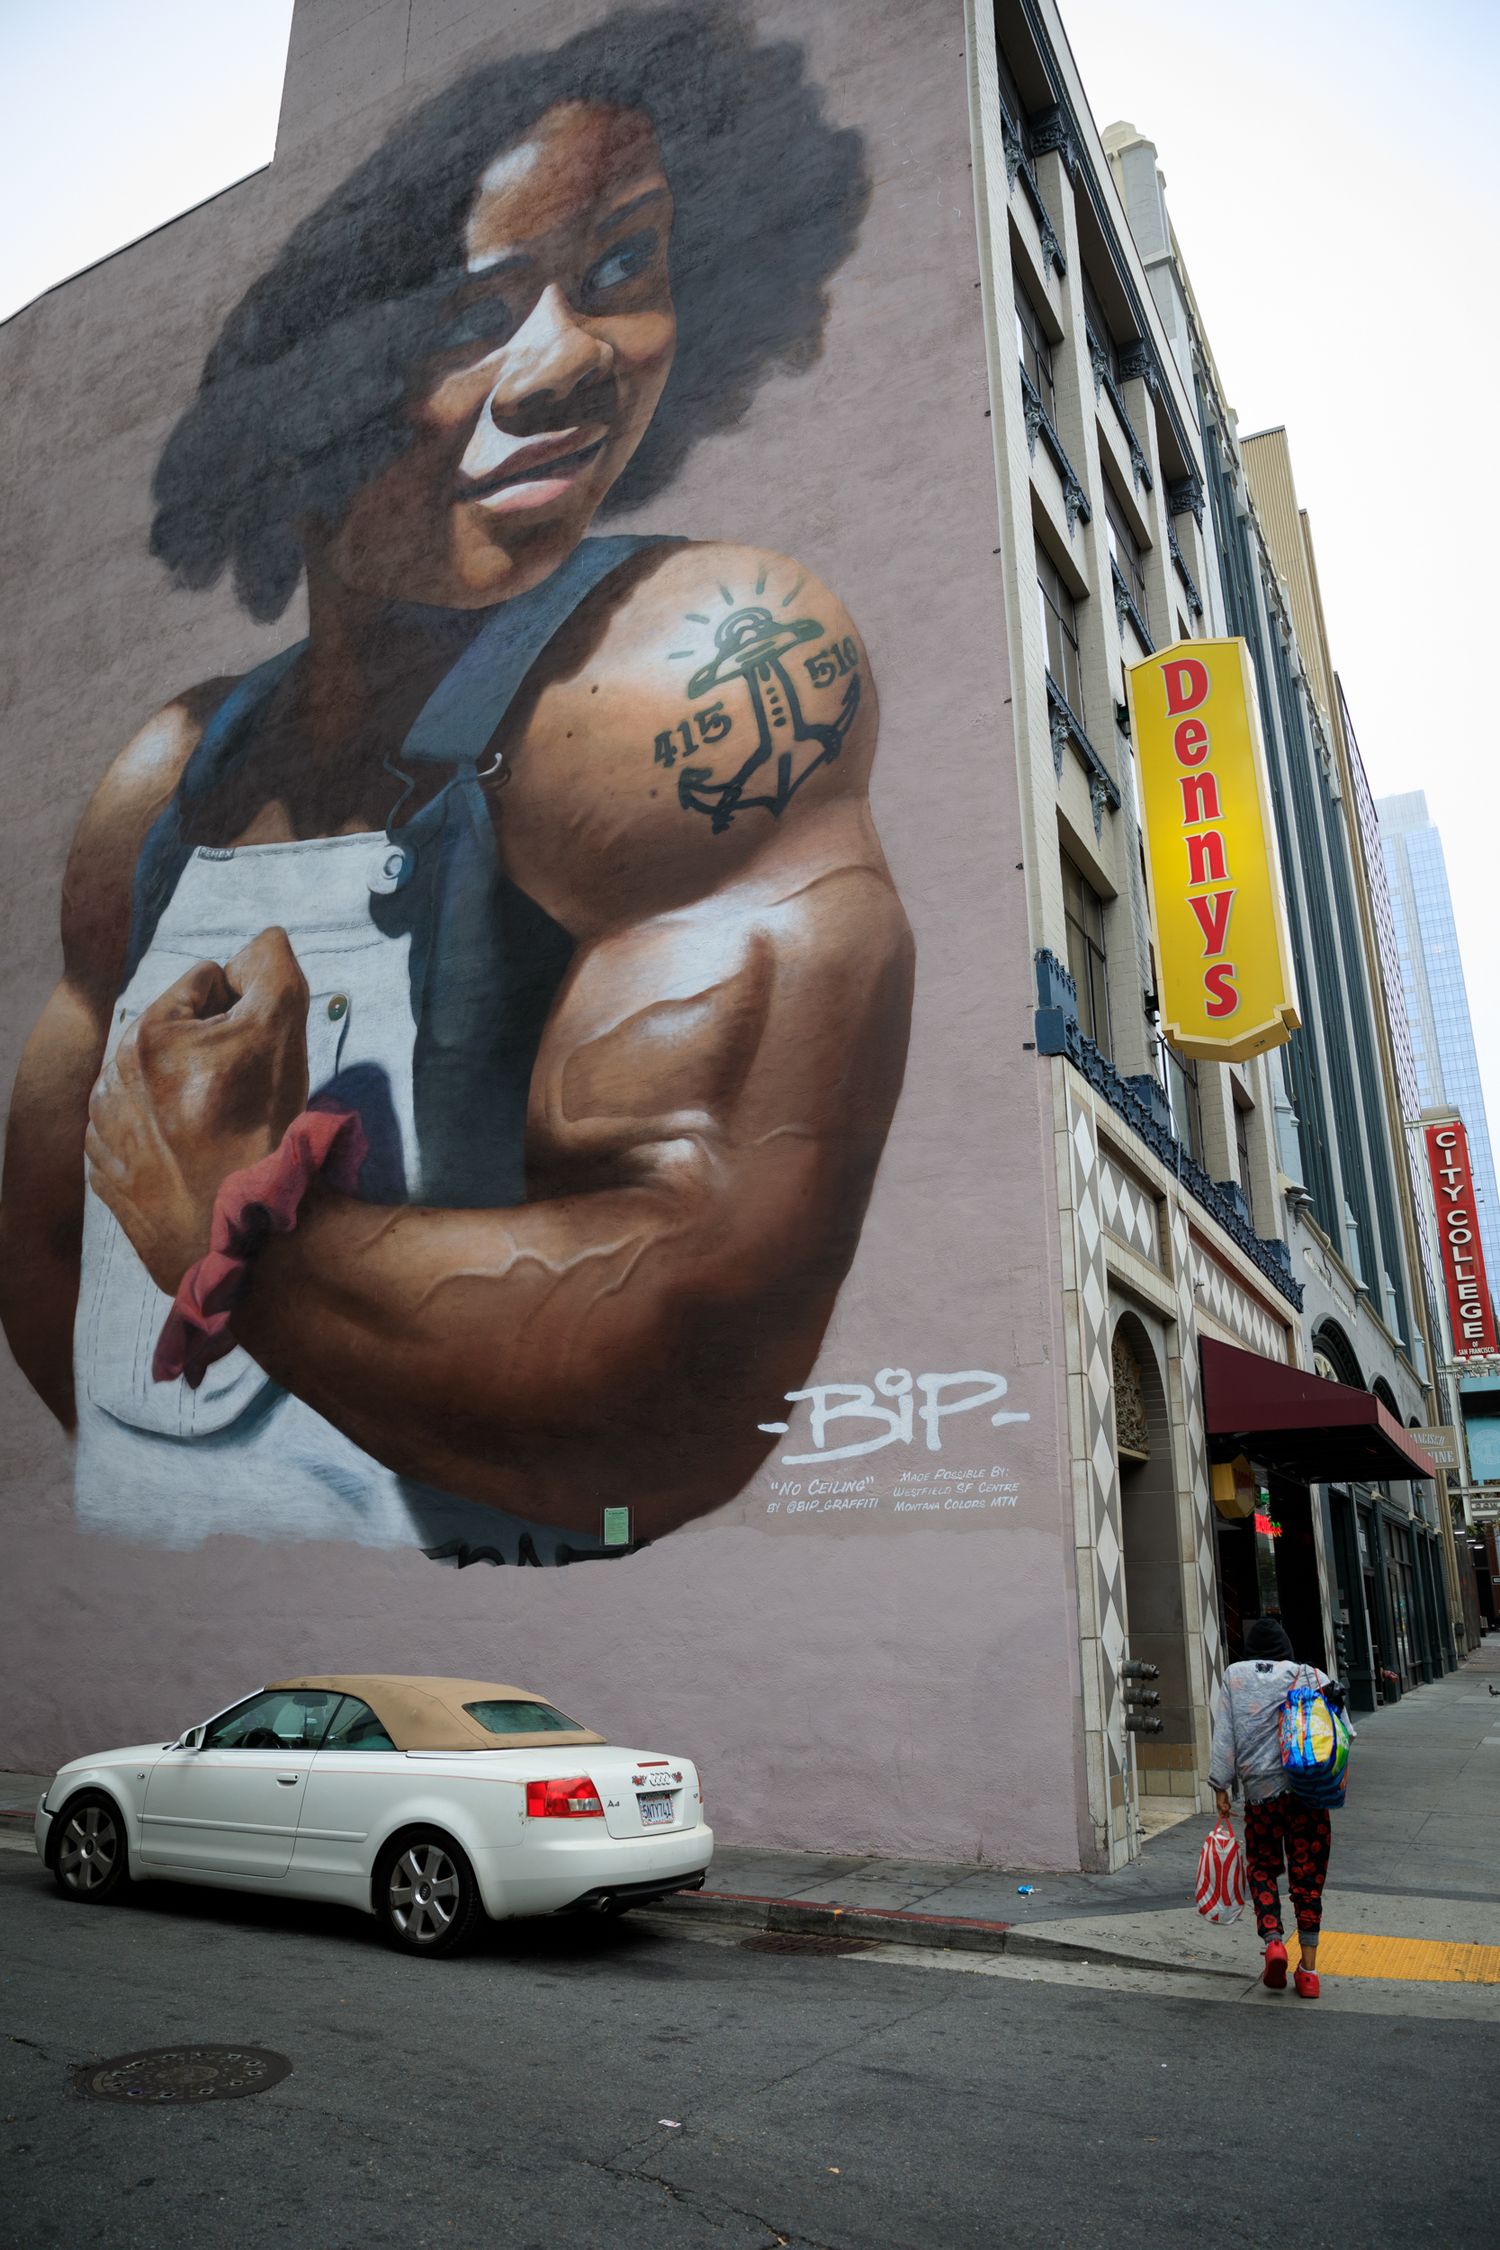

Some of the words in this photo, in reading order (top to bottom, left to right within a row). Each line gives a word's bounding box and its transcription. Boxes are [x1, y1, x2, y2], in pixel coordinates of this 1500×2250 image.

[804, 635, 858, 689] 510
[653, 701, 732, 768] 415
[1159, 658, 1239, 1019] Dennys
[1435, 1131, 1464, 1202] CITY
[1447, 1210, 1484, 1339] COLLEGE
[1468, 1346, 1495, 1355] FRANCISCO
[955, 1482, 974, 1494] SF
[766, 1502, 780, 1513] BY
[786, 1497, 879, 1514] @BIP_GRAFFITI
[990, 1495, 1018, 1507] MTN
[607, 1799, 620, 1808] A4
[642, 1801, 671, 1819] 5NTY741
